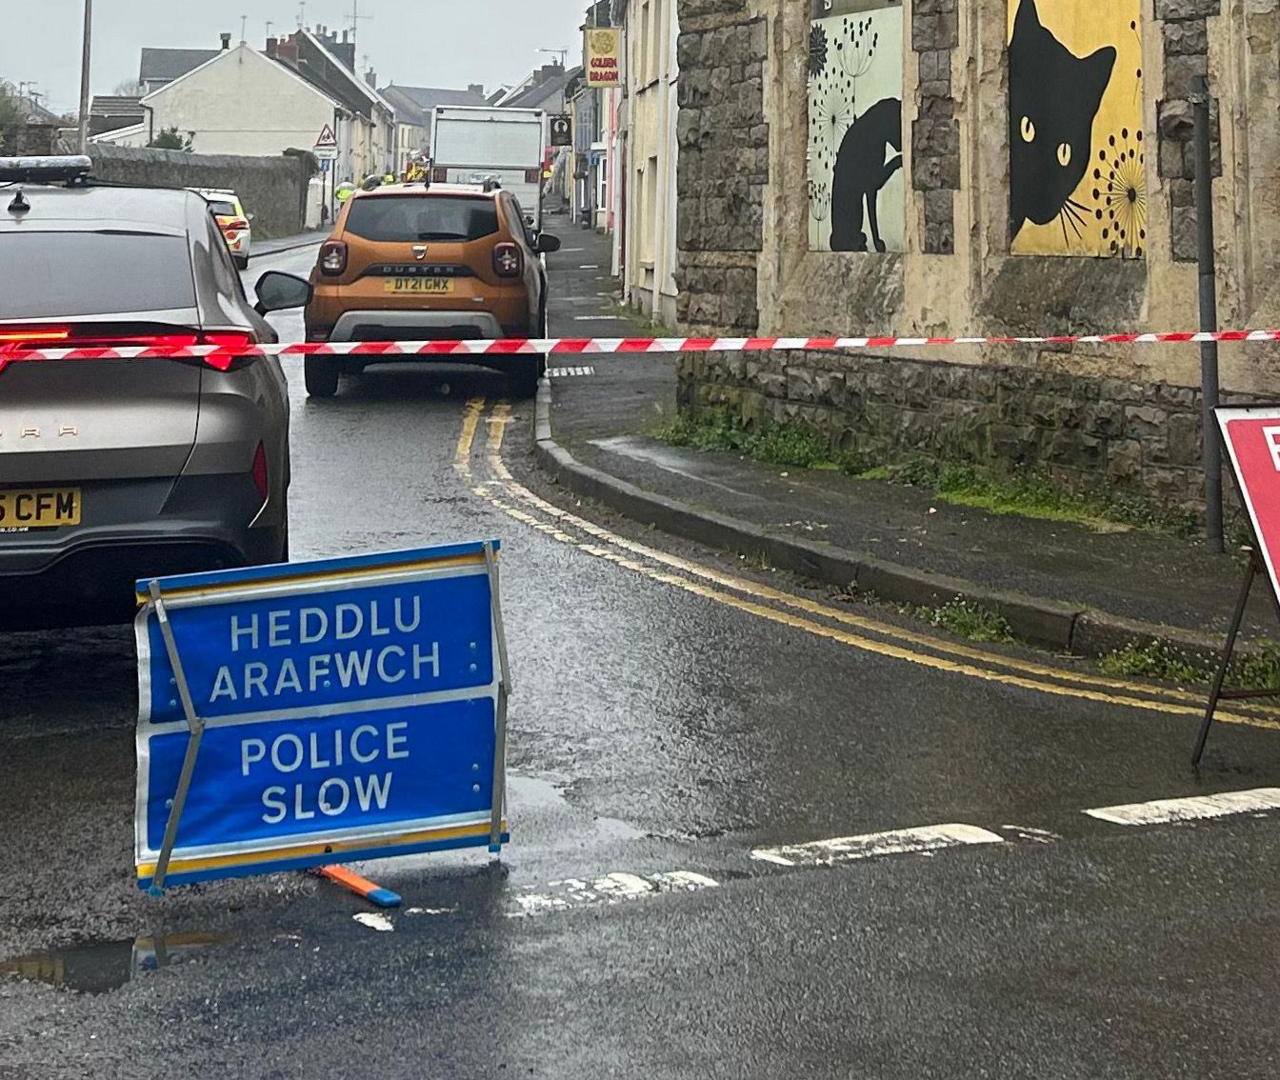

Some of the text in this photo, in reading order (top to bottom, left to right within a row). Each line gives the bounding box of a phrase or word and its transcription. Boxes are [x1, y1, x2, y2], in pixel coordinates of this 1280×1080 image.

[589, 71, 619, 82] DRAGON
[15, 492, 74, 521] CFM
[231, 596, 420, 652] HEDDLU
[209, 642, 440, 703] ARAFWCH
[241, 722, 410, 776] POLICE
[261, 772, 393, 825] SLOW
